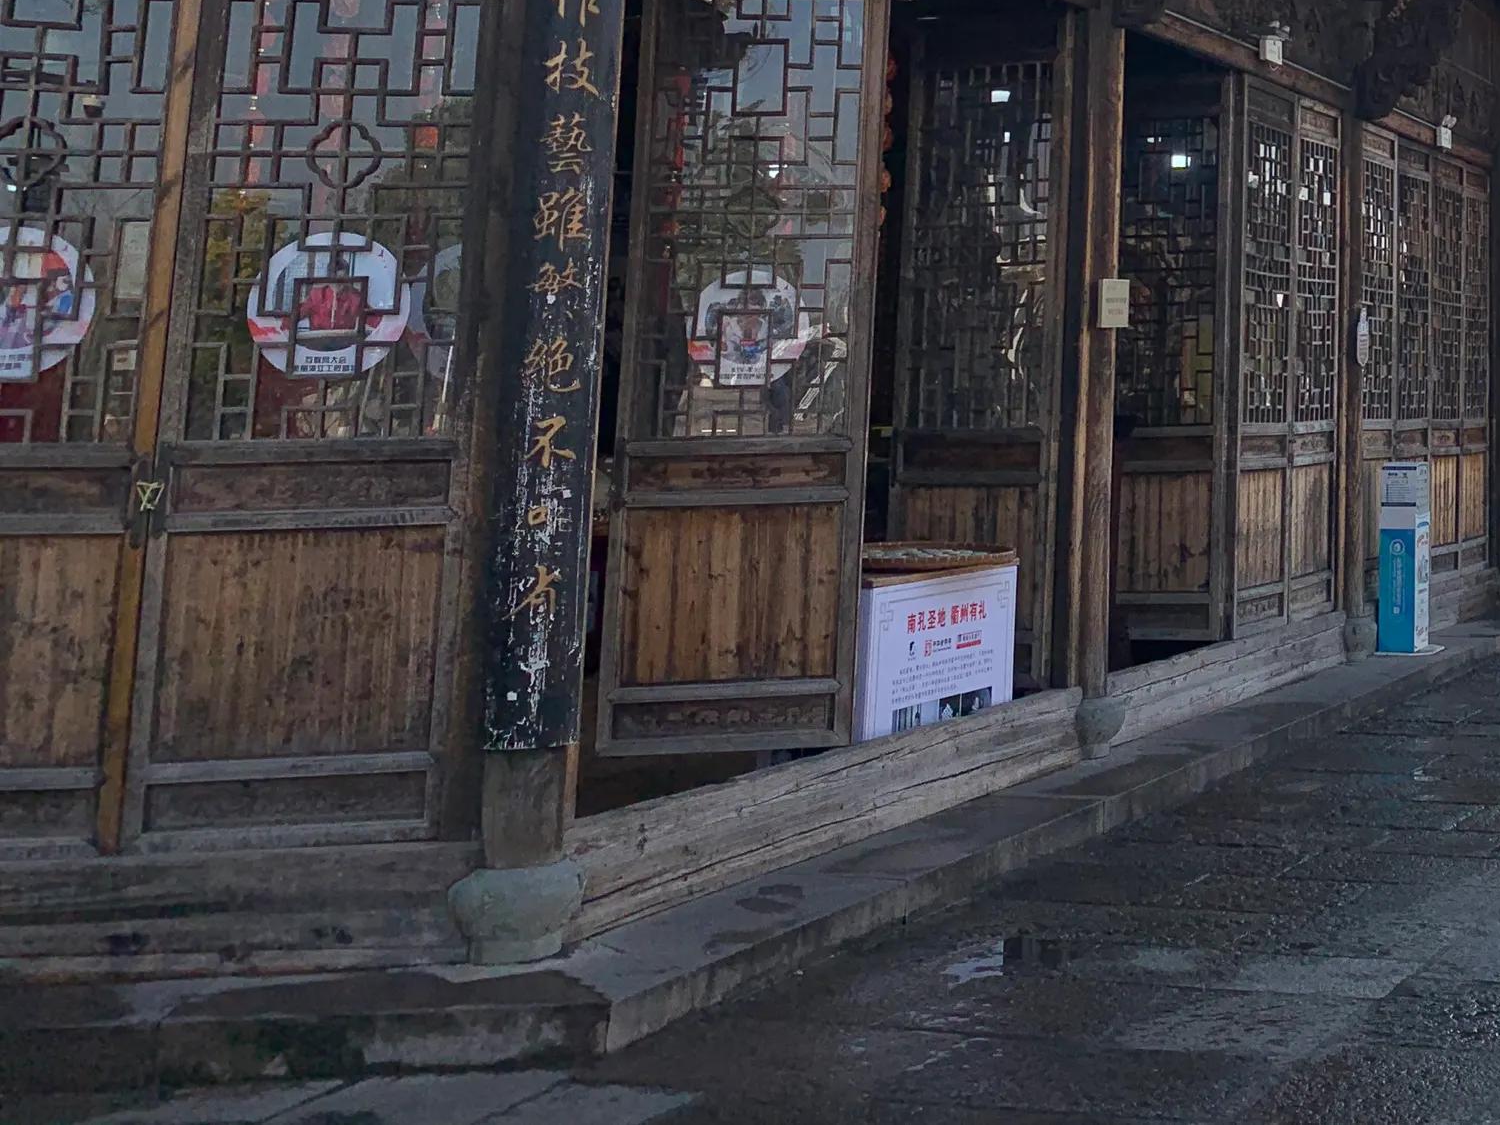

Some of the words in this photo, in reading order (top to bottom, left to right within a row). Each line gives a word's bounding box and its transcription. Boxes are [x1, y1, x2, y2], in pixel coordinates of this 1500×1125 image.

[907, 607, 946, 634] 南孔圣地
[950, 599, 987, 625] 衢州有礼
